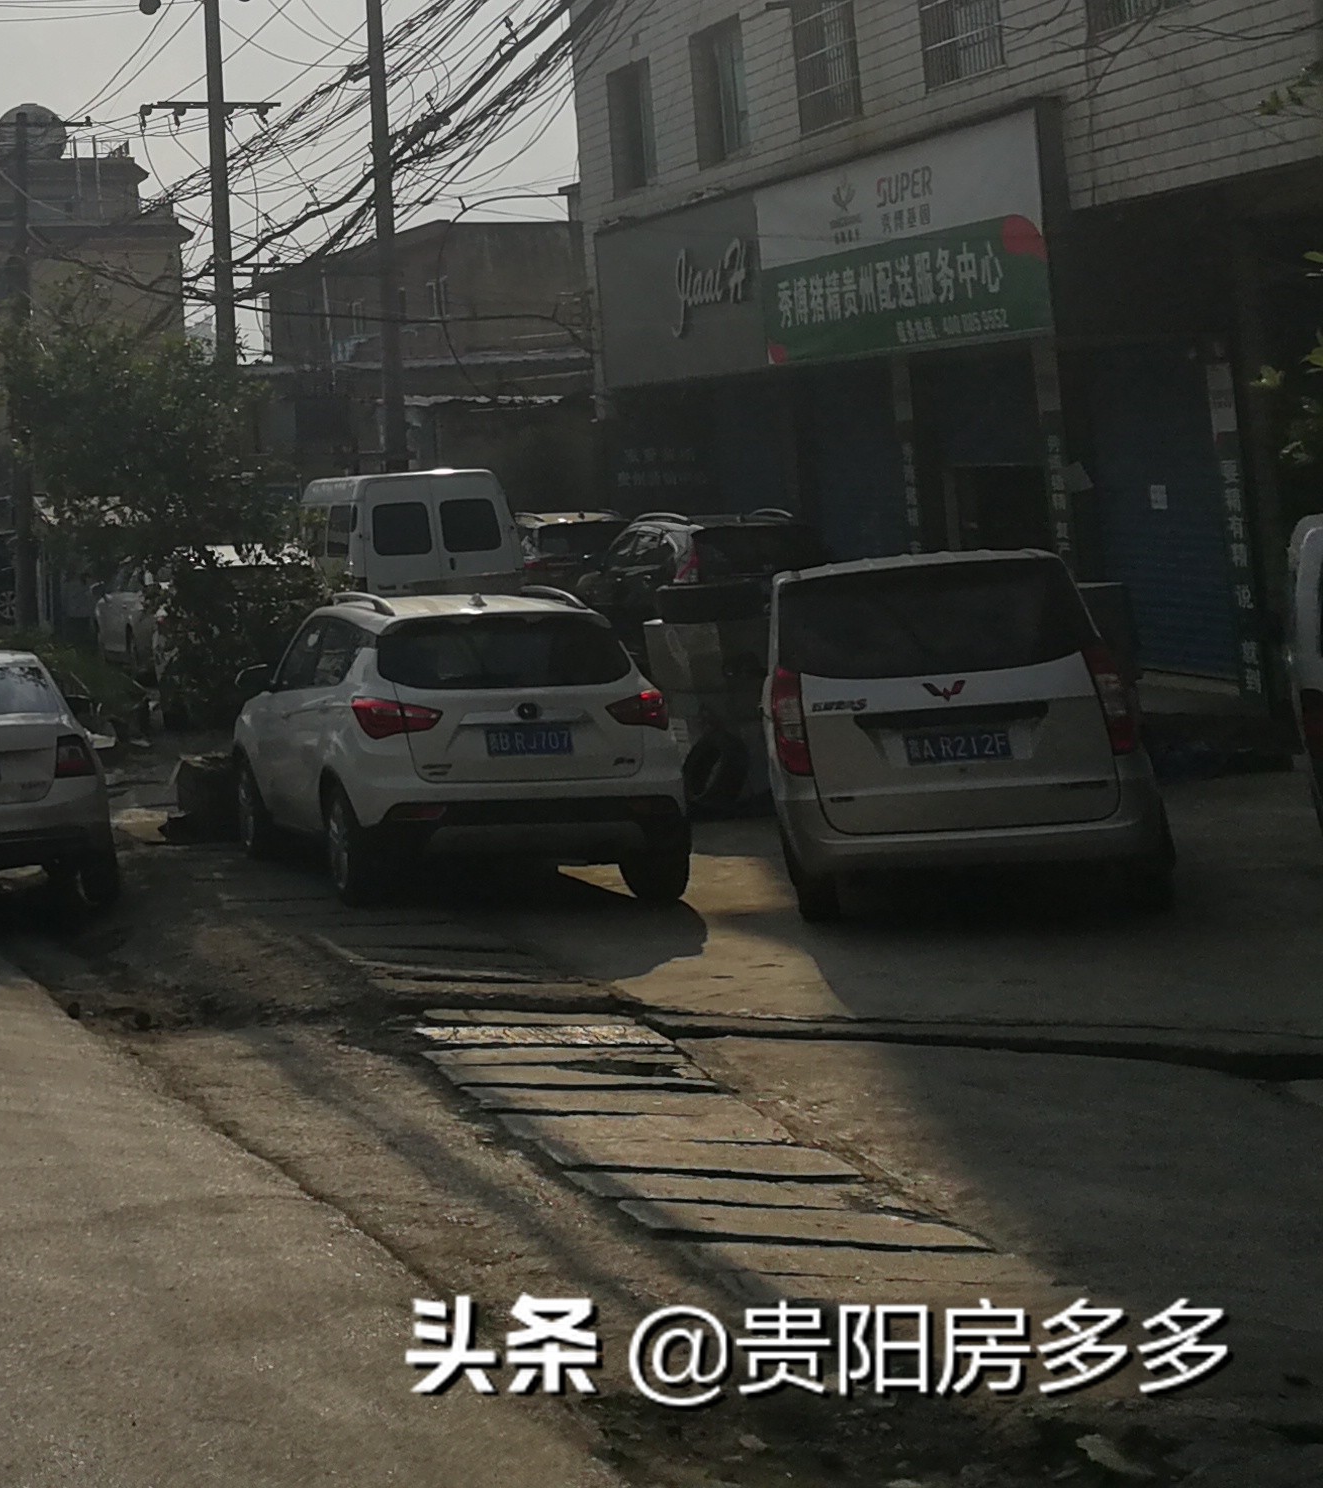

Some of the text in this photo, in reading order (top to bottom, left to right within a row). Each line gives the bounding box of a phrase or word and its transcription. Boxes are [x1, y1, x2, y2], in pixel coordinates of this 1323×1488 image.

[877, 165, 932, 208] SUPER
[777, 240, 1003, 329] 秀博猪精贵州配送服务中心
